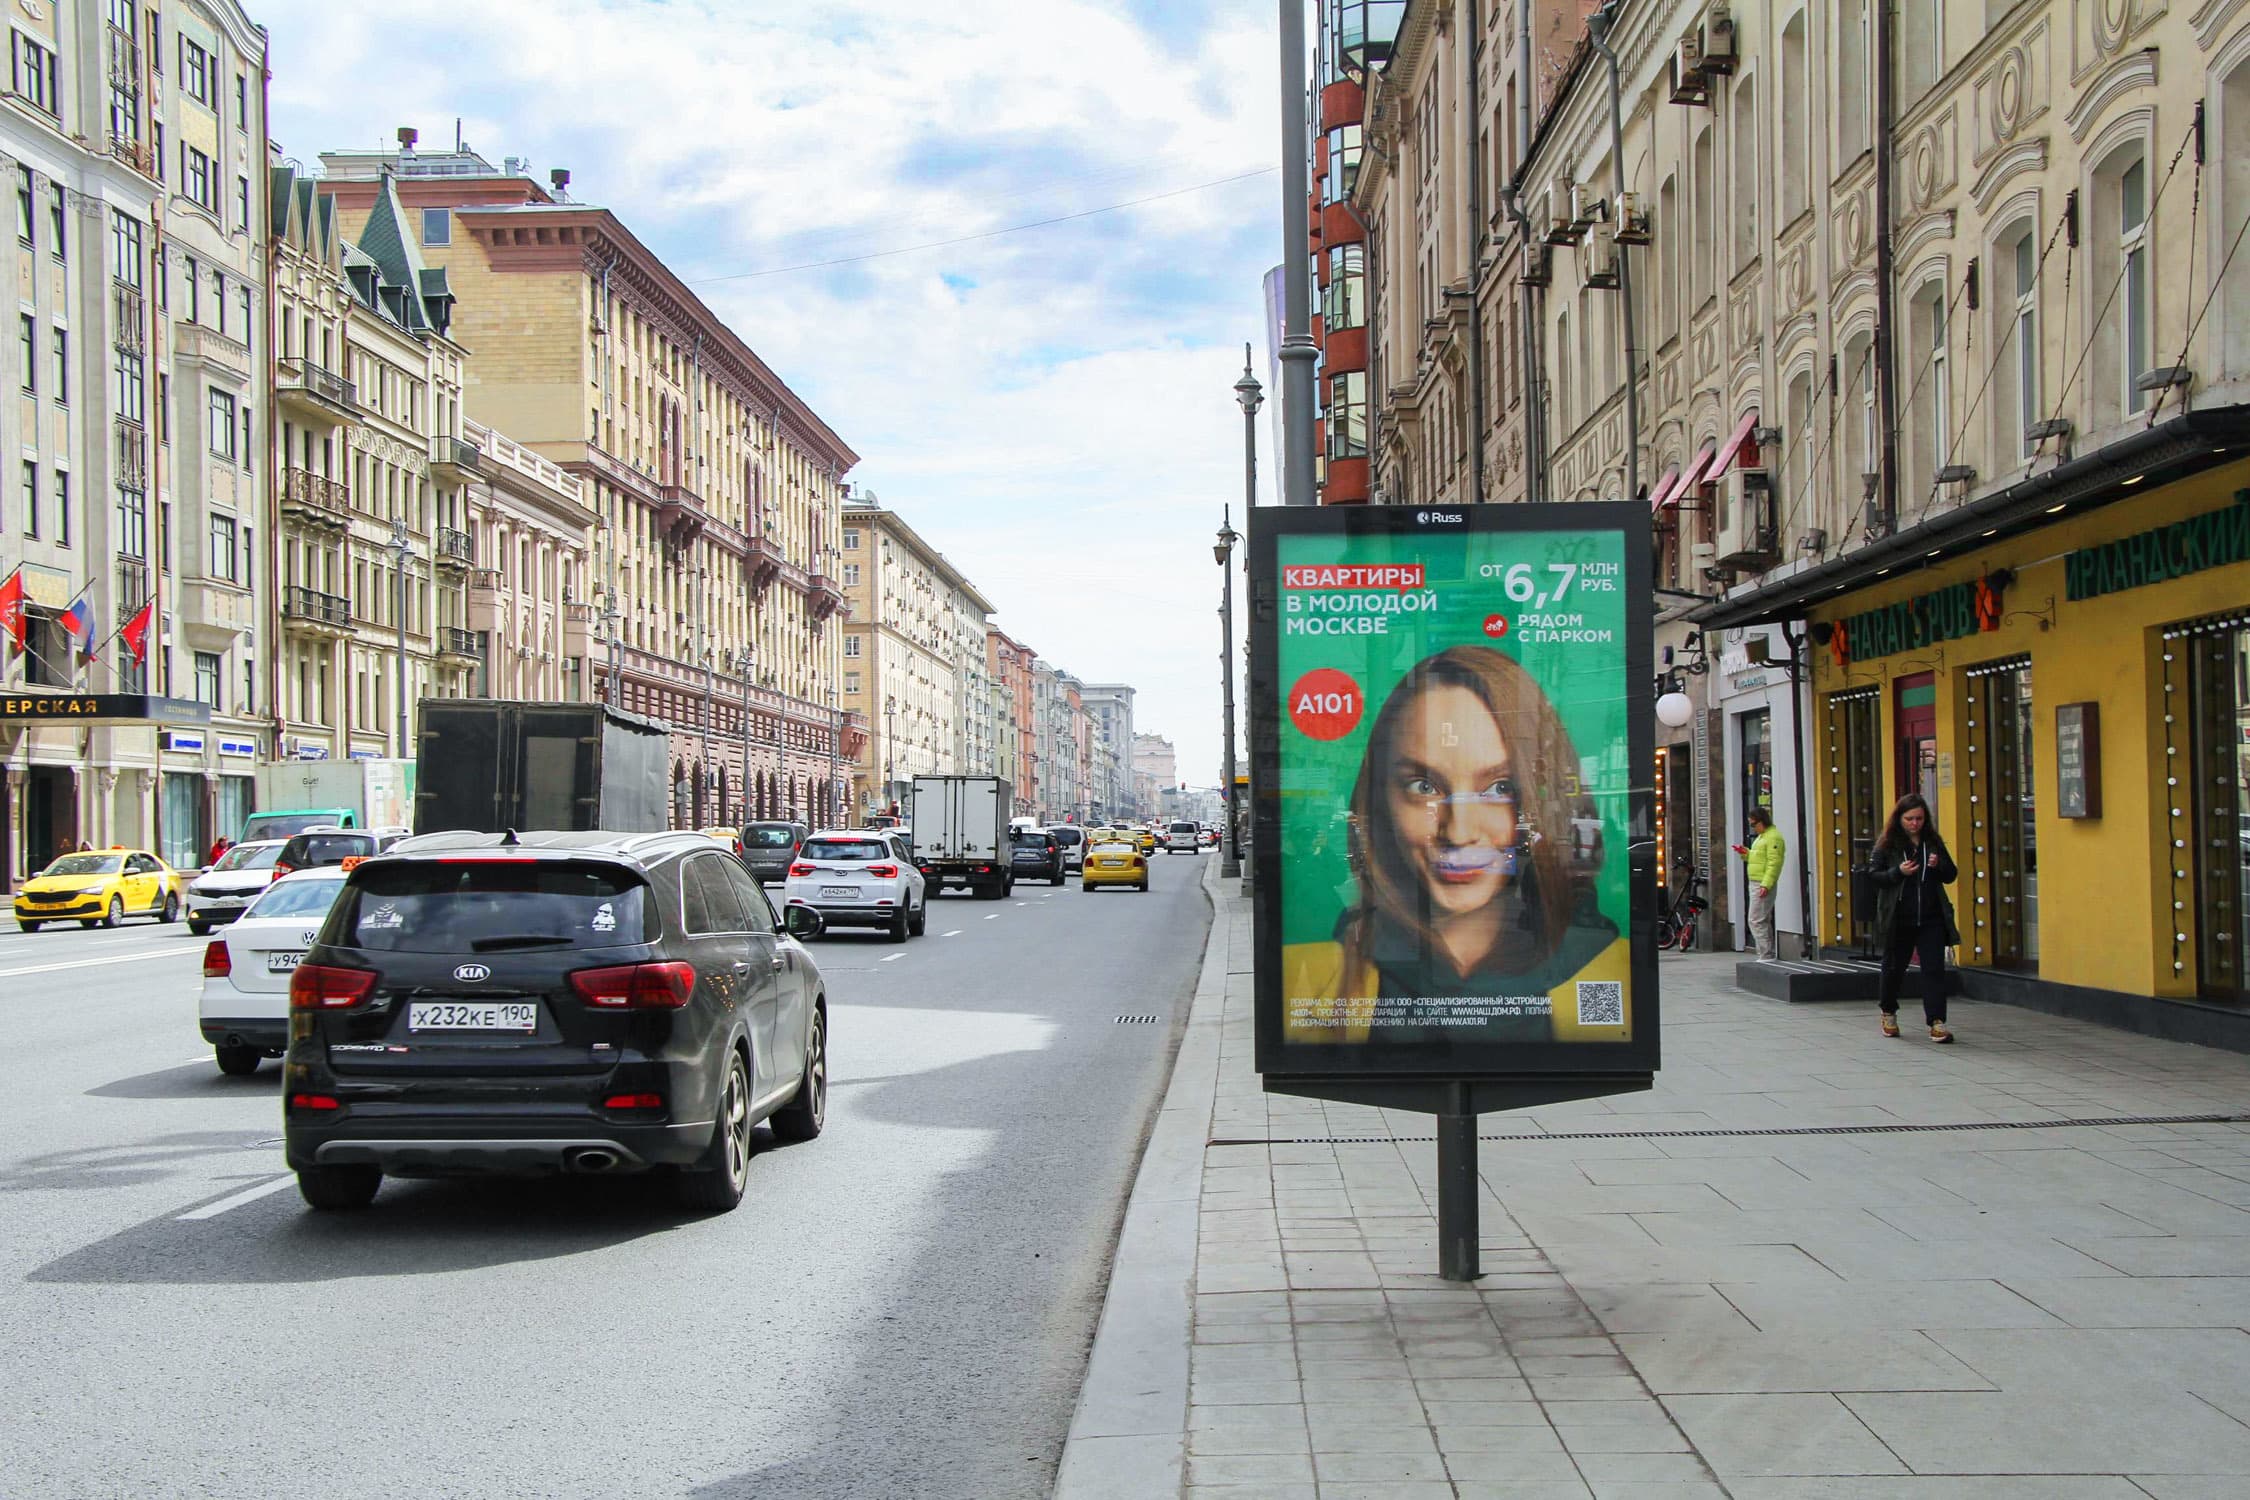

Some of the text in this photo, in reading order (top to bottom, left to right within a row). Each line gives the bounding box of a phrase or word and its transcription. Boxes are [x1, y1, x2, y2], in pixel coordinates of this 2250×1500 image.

[1431, 512, 1463, 523] Russ
[1286, 568, 1420, 586] КВАРТИРЫ
[1480, 563, 1618, 609] ОТ 6,7 МЛН
[1581, 579, 1617, 591] РУБ.
[1286, 590, 1437, 614] В МОЛОДОЙ
[1286, 617, 1388, 635] МОСКВЕ
[1518, 614, 1582, 629] РЯДОМ
[1849, 582, 1970, 663] HARAT'S PUB
[1518, 630, 1612, 642] С ПАРКОМ
[0, 700, 96, 713] ЕРСКАЯ
[458, 967, 484, 978] KIA
[500, 1005, 530, 1020] 190
